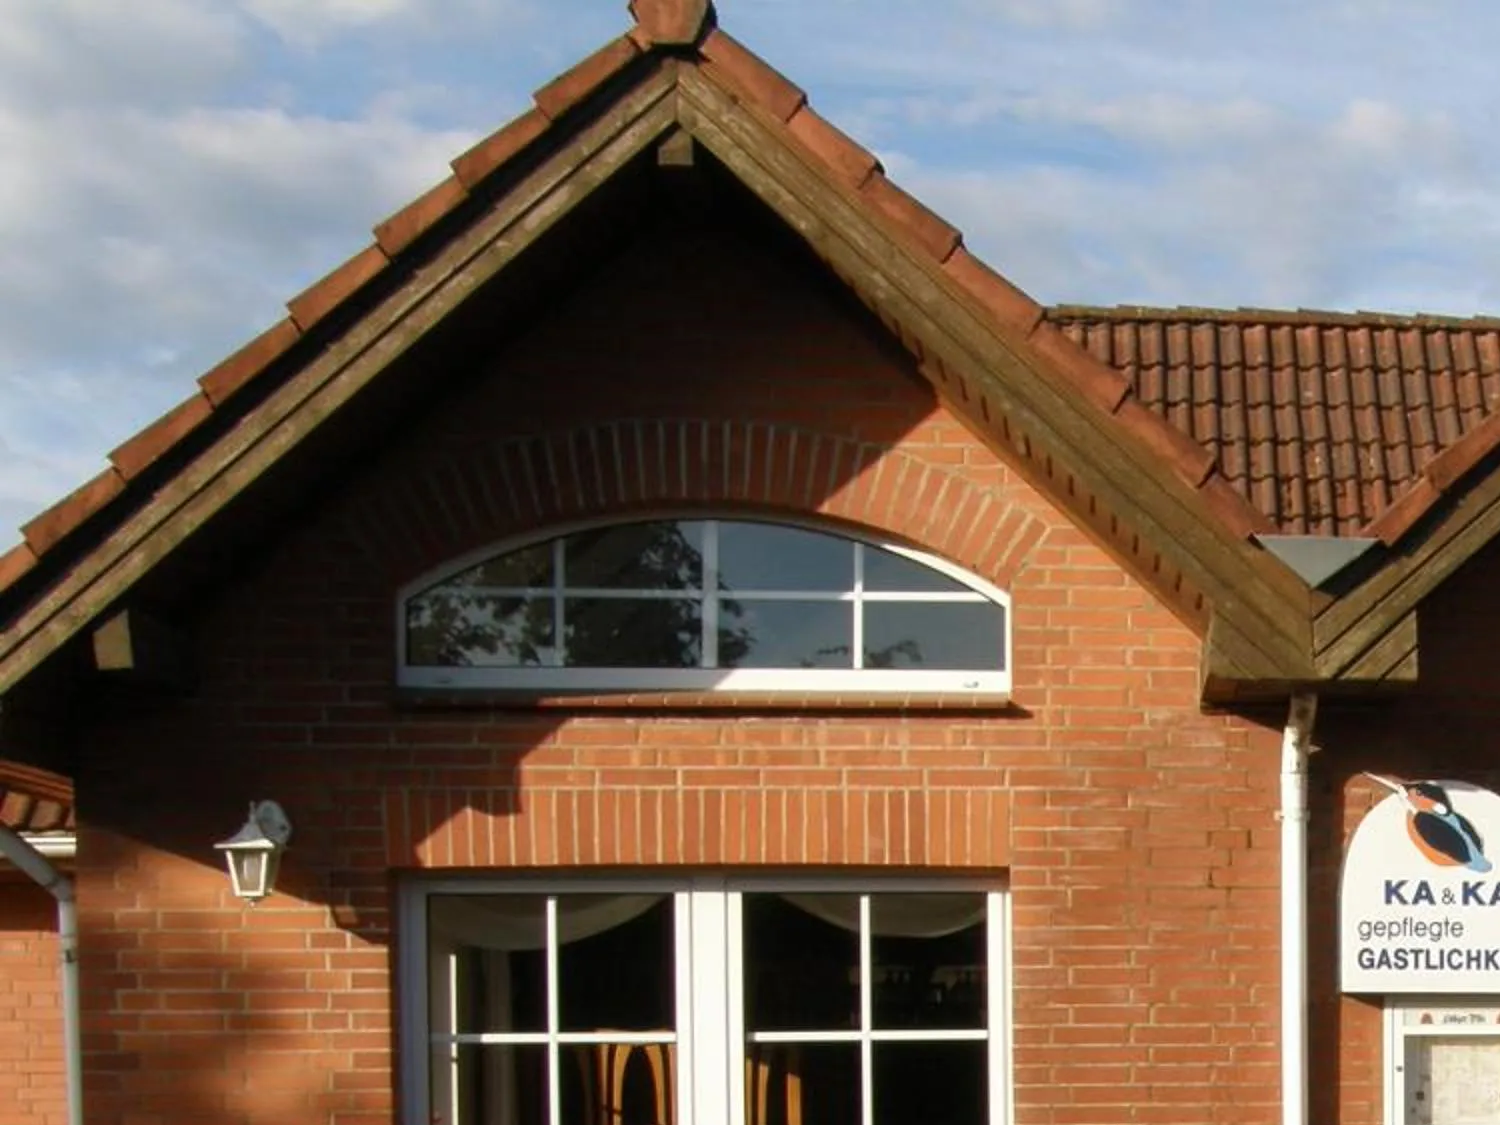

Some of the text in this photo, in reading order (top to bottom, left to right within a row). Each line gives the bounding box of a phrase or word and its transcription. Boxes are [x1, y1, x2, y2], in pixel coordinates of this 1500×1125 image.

[1383, 879, 1437, 906] KA
[1441, 887, 1457, 905] &
[1357, 916, 1465, 942] gepflegte
